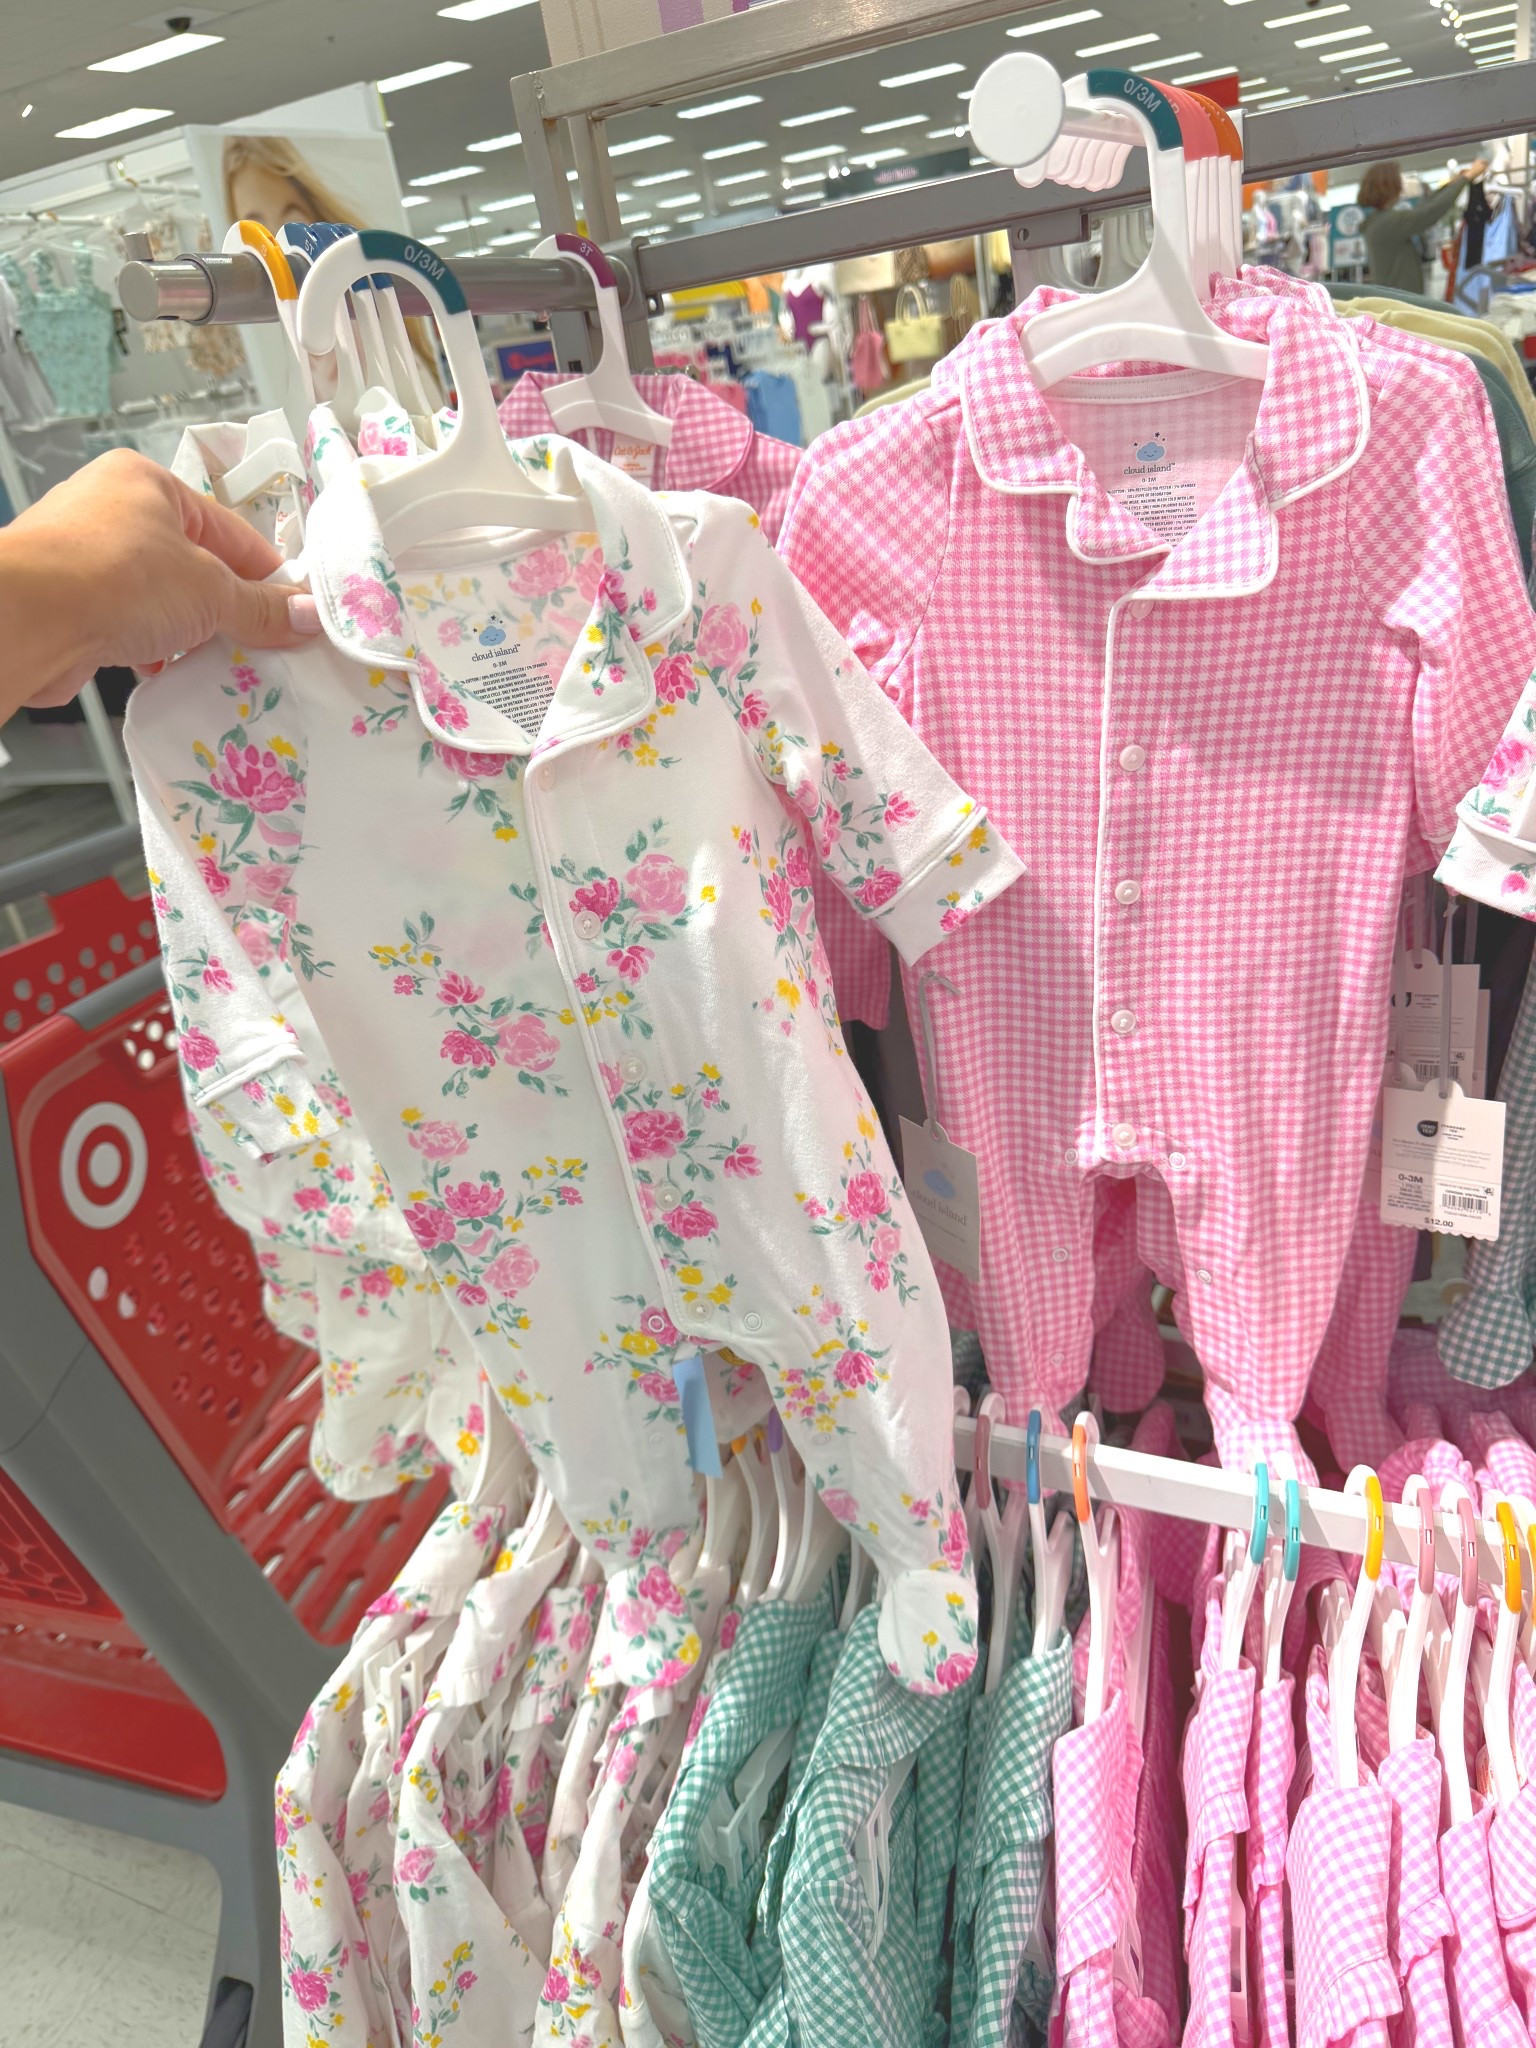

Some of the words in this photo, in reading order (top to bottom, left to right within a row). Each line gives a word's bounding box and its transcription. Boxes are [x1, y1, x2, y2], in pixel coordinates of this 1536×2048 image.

[1124, 79, 1162, 112] 0/3M
[304, 239, 314, 255] 5T
[580, 242, 593, 256] 3T
[404, 245, 446, 280] 0/3M
[1124, 465, 1145, 475] cloud
[472, 650, 493, 662] cloud
[493, 660, 508, 668] 0-3M
[1398, 1173, 1423, 1183] 0-3M
[1424, 1217, 1454, 1228] $12.00
